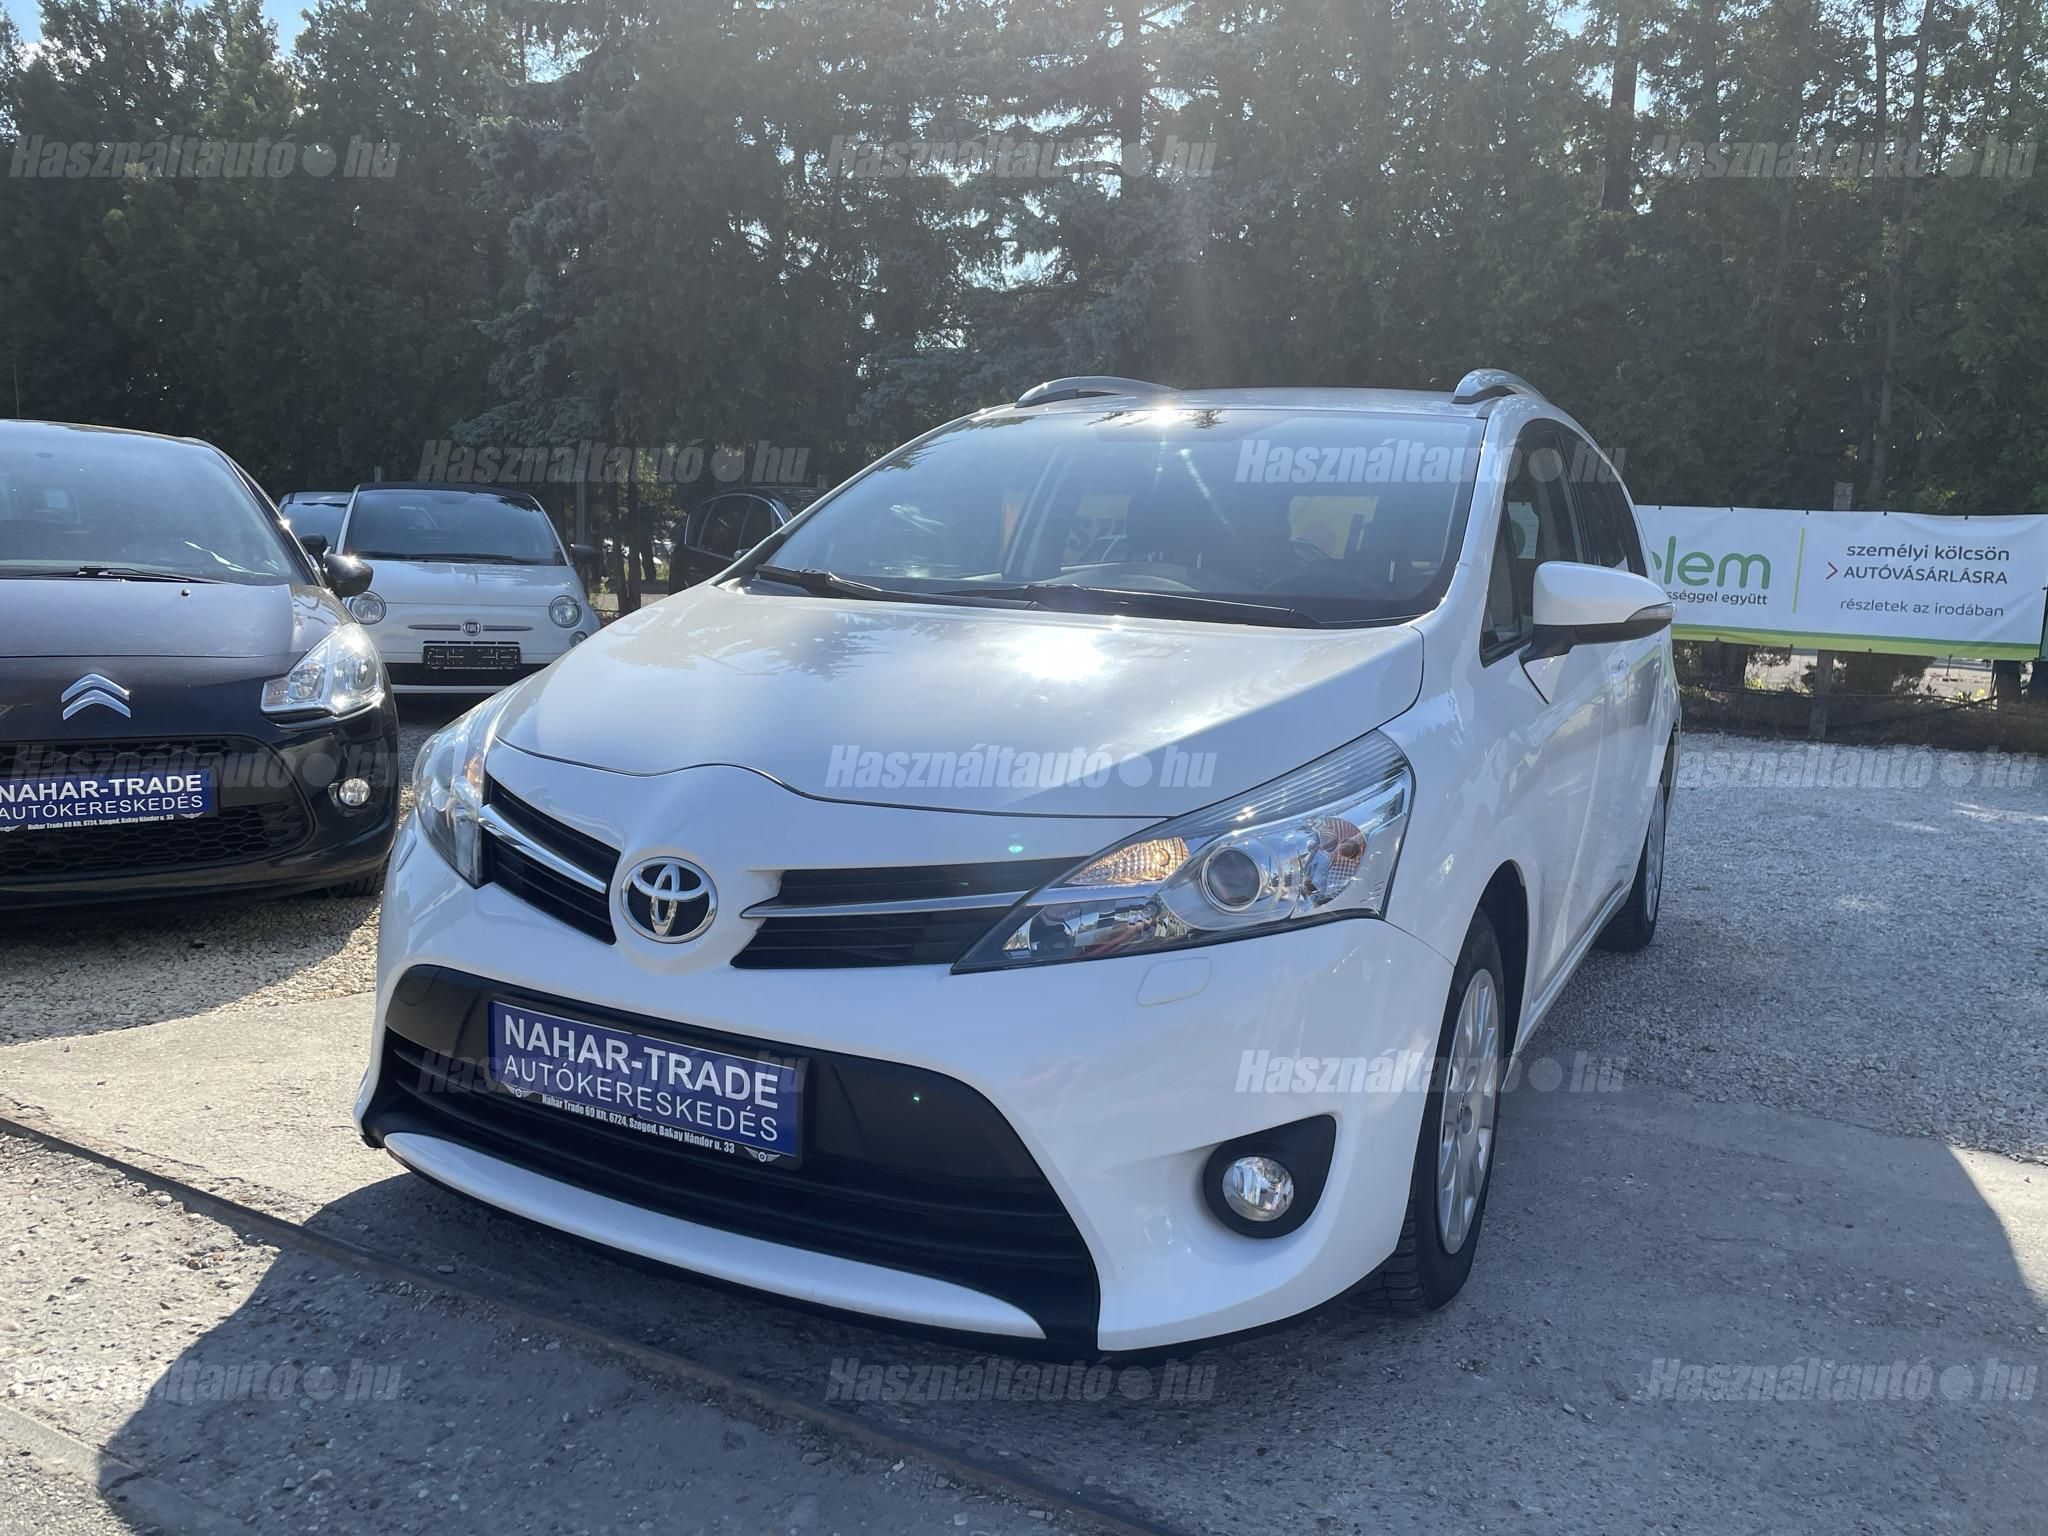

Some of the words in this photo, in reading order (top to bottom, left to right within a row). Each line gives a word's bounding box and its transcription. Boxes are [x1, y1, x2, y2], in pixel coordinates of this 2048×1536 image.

[1846, 543, 1928, 562] személyi
[1934, 545, 2010, 561] kölcsön
[1843, 564, 2008, 584] AUTÓVÁSÁRLÁSRA
[1721, 592, 1768, 606] együtt
[1839, 598, 1909, 613] részletek
[1912, 603, 1930, 614] az
[1934, 602, 2004, 617] irodában
[0, 774, 202, 803] NAHAR-TRADE
[0, 793, 203, 820] AUTÓKERESKEDÉS
[505, 1014, 778, 1109] NAHAR-TRADE
[504, 1055, 778, 1142] AUTÓKERESKEDÉS
[541, 1094, 563, 1109] Nahar
[563, 1100, 584, 1115] Trade
[585, 1106, 596, 1118] 69
[629, 1117, 658, 1136] Szeged,
[659, 1125, 683, 1142] Bakay
[684, 1131, 714, 1149] Nándor
[714, 1140, 722, 1151] u.
[724, 1141, 735, 1154] 33
